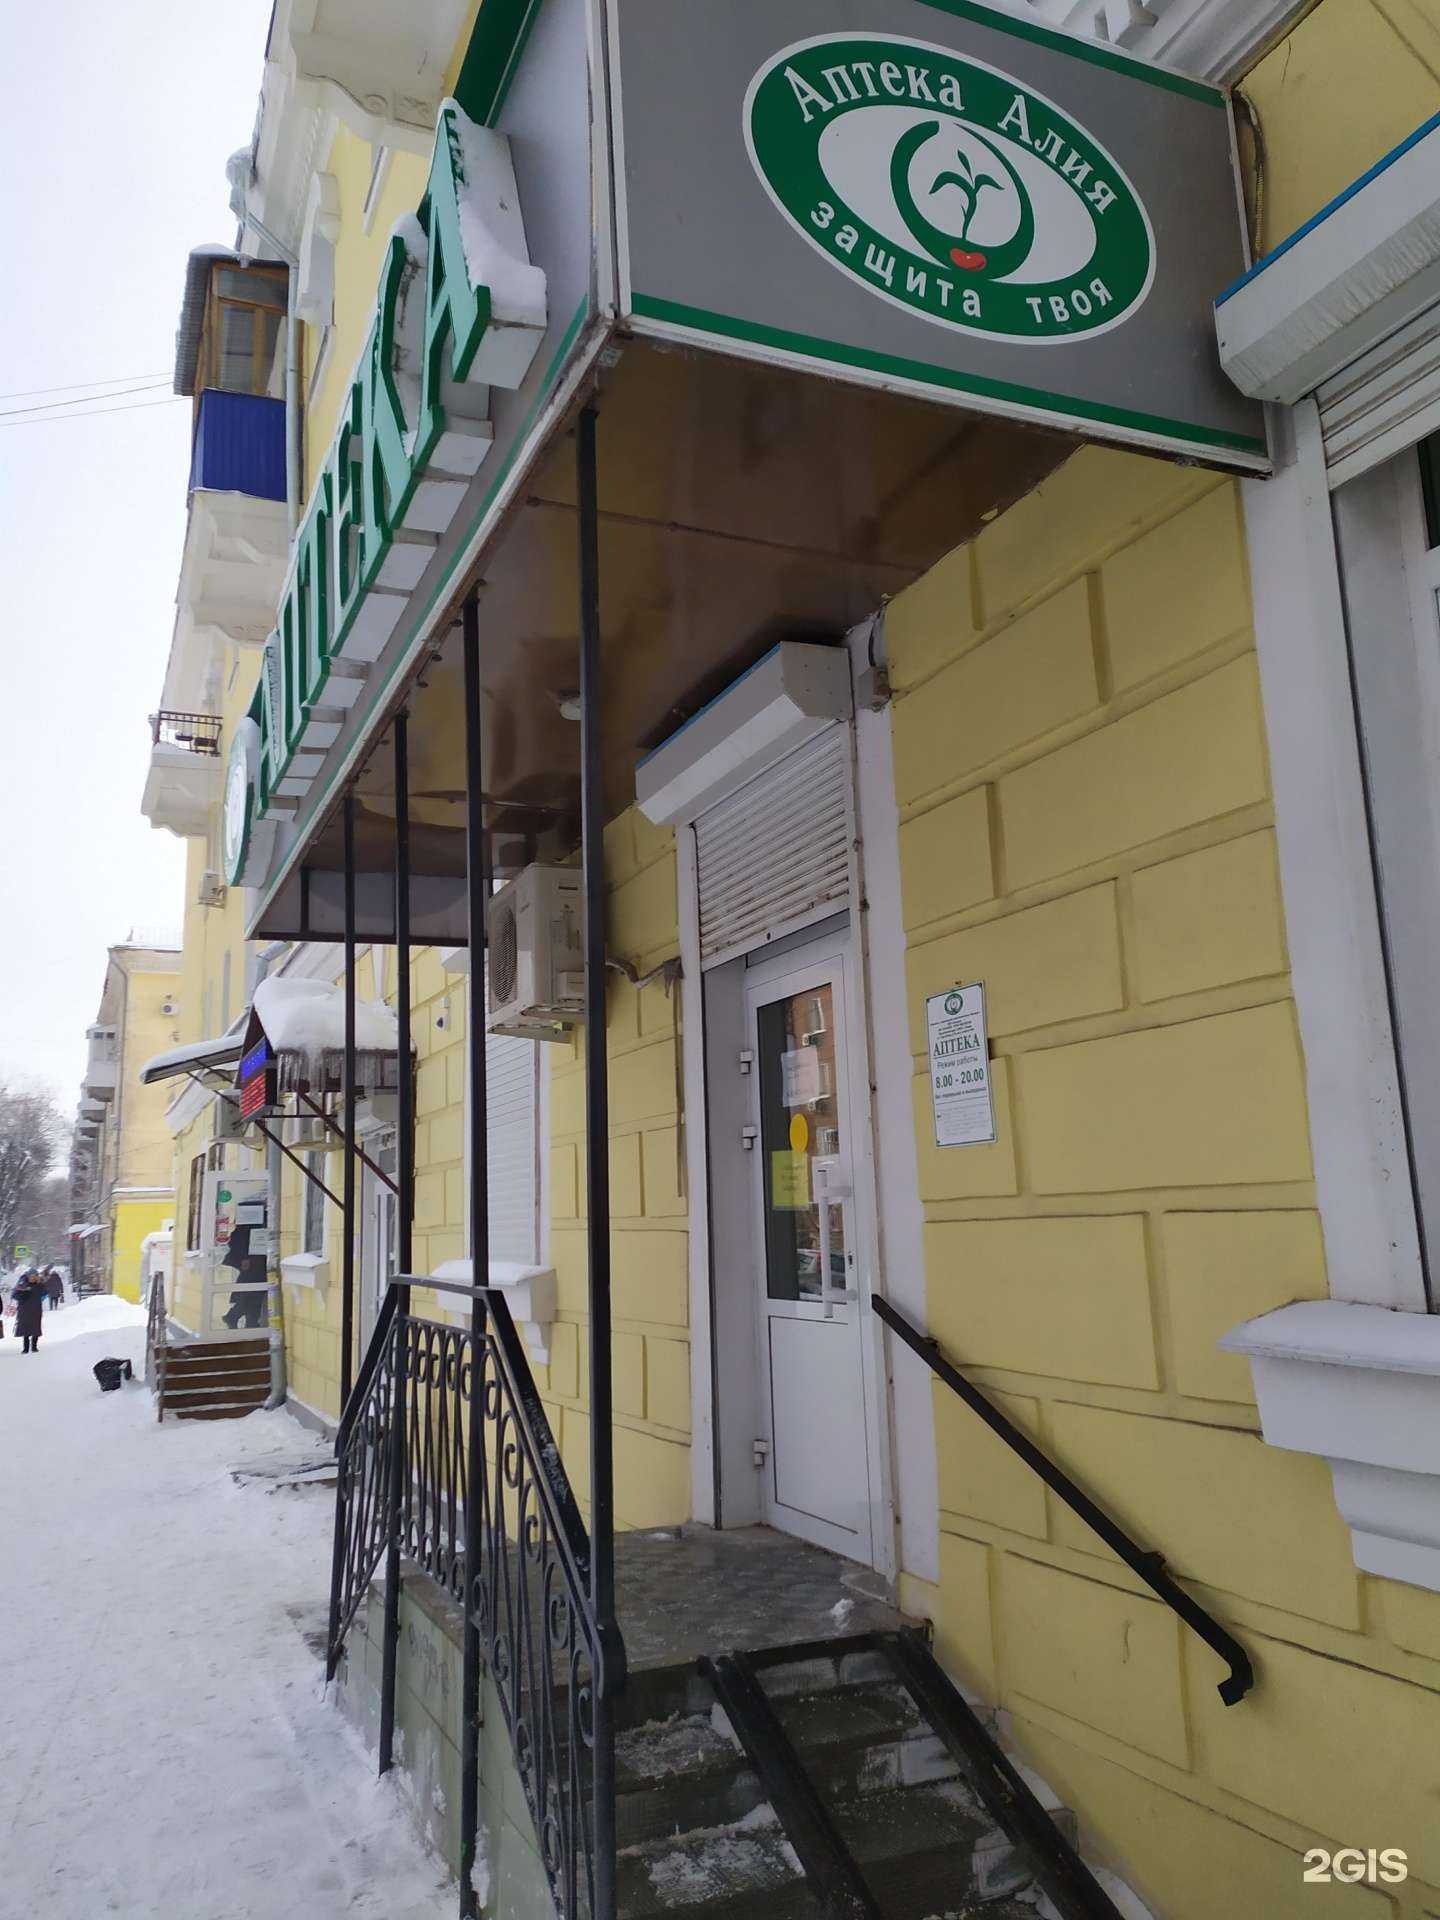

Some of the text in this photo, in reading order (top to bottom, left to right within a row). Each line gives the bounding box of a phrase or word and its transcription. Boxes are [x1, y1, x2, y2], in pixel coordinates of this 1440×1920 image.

[784, 61, 1118, 215] Аптека Алия
[810, 201, 1113, 323] защита твоя
[256, 106, 494, 820] АПТЕКА
[933, 1033, 980, 1057] АПТЕКА
[935, 1074, 953, 1089] 8.00
[961, 1068, 985, 1084] 20.00
